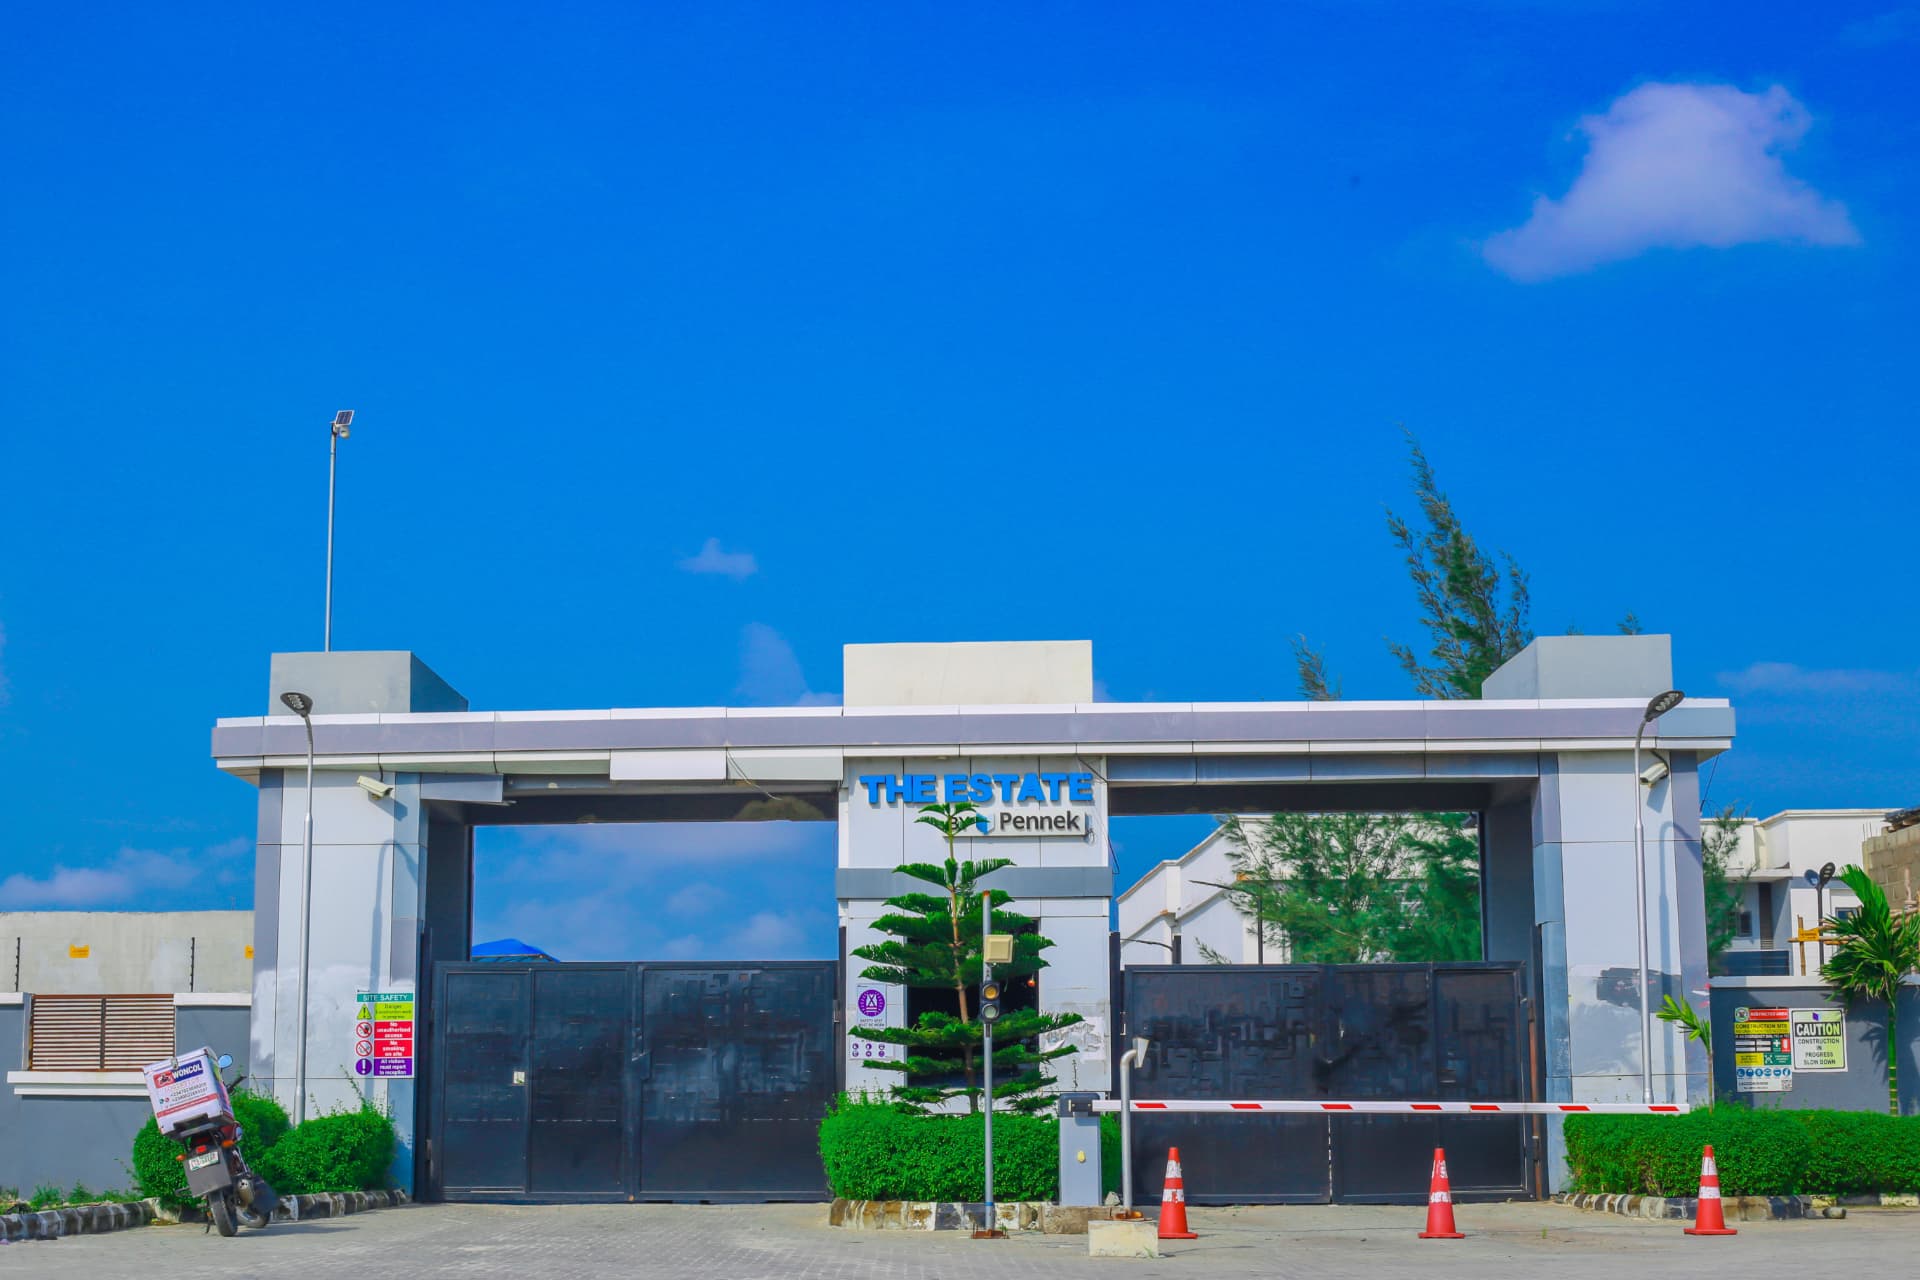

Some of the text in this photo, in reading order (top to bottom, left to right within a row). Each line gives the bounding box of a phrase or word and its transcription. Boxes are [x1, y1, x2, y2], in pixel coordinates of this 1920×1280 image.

[859, 772, 1093, 803] THE ESTATE
[1000, 811, 1080, 830] Pennek
[1796, 1023, 1840, 1036] CAUTION
[172, 1063, 203, 1079] WONCOL
